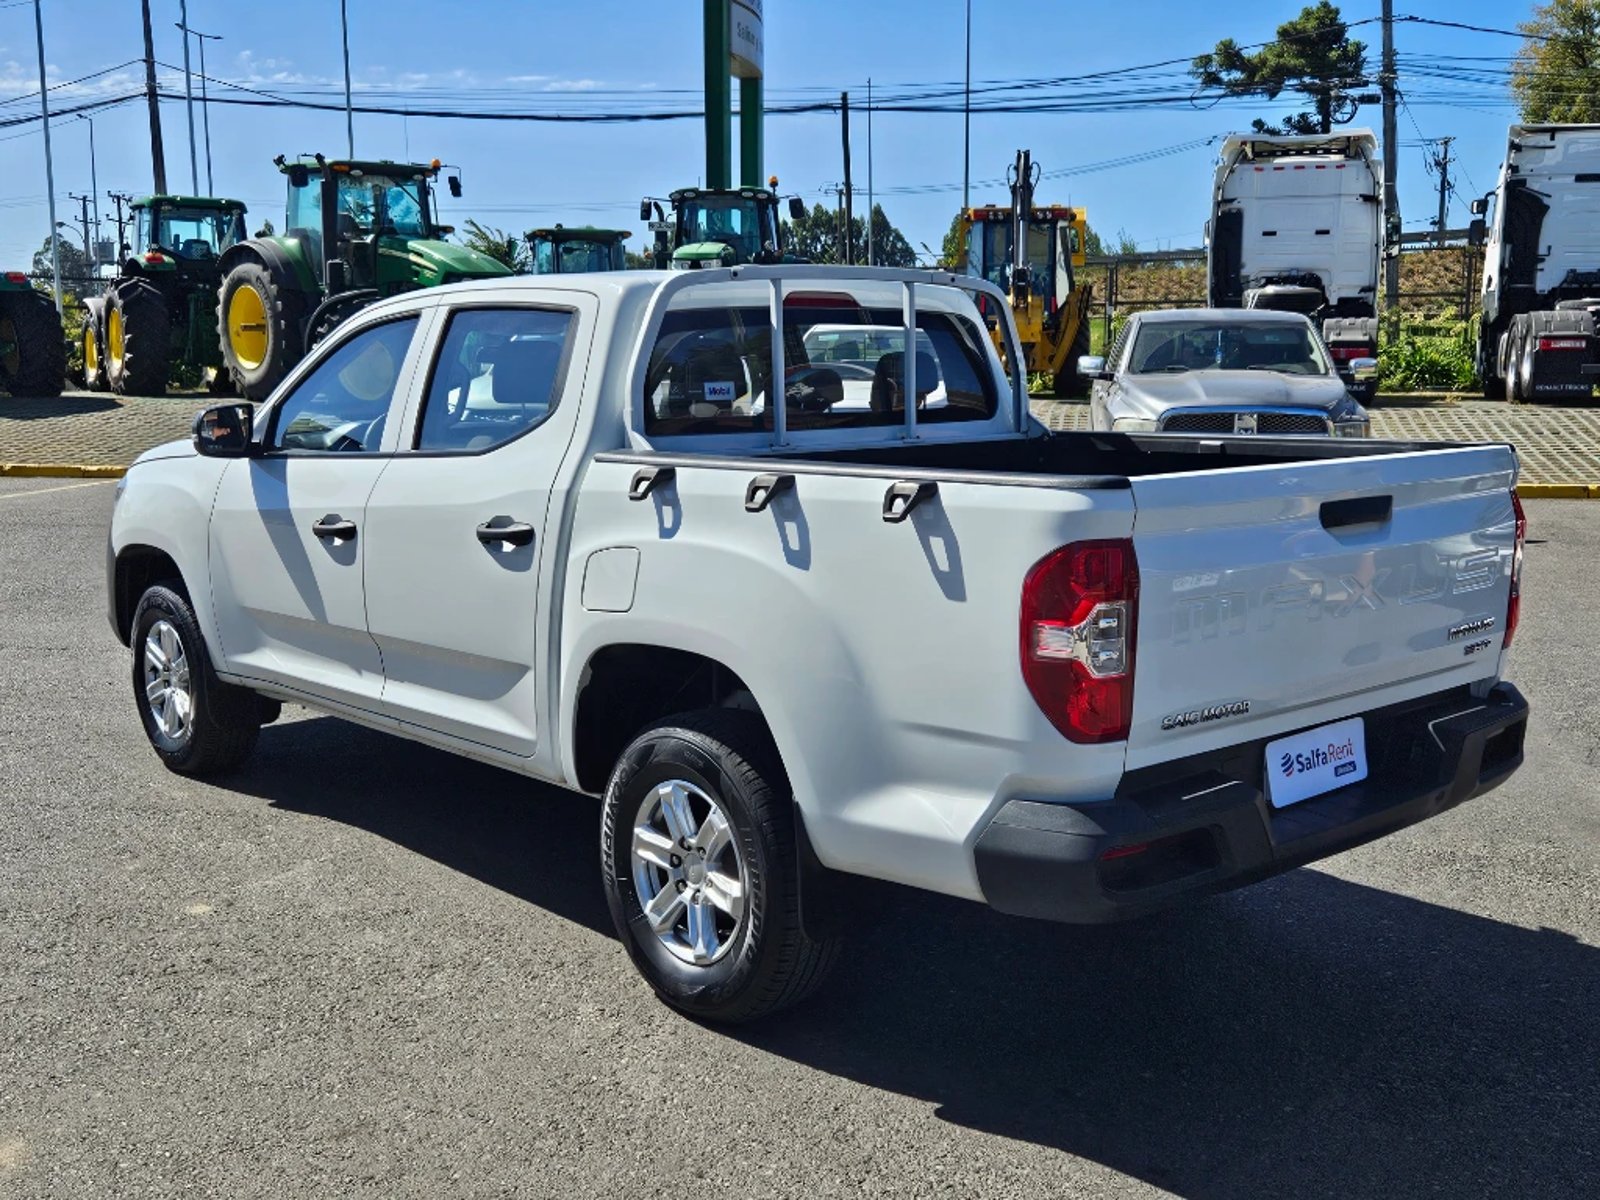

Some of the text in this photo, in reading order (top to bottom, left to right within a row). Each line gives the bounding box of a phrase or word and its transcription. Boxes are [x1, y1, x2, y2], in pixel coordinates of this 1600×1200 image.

[708, 386, 731, 396] Mobil
[1161, 699, 1251, 731] SAIC MOTOR
[1295, 737, 1354, 774] SalfaRent
